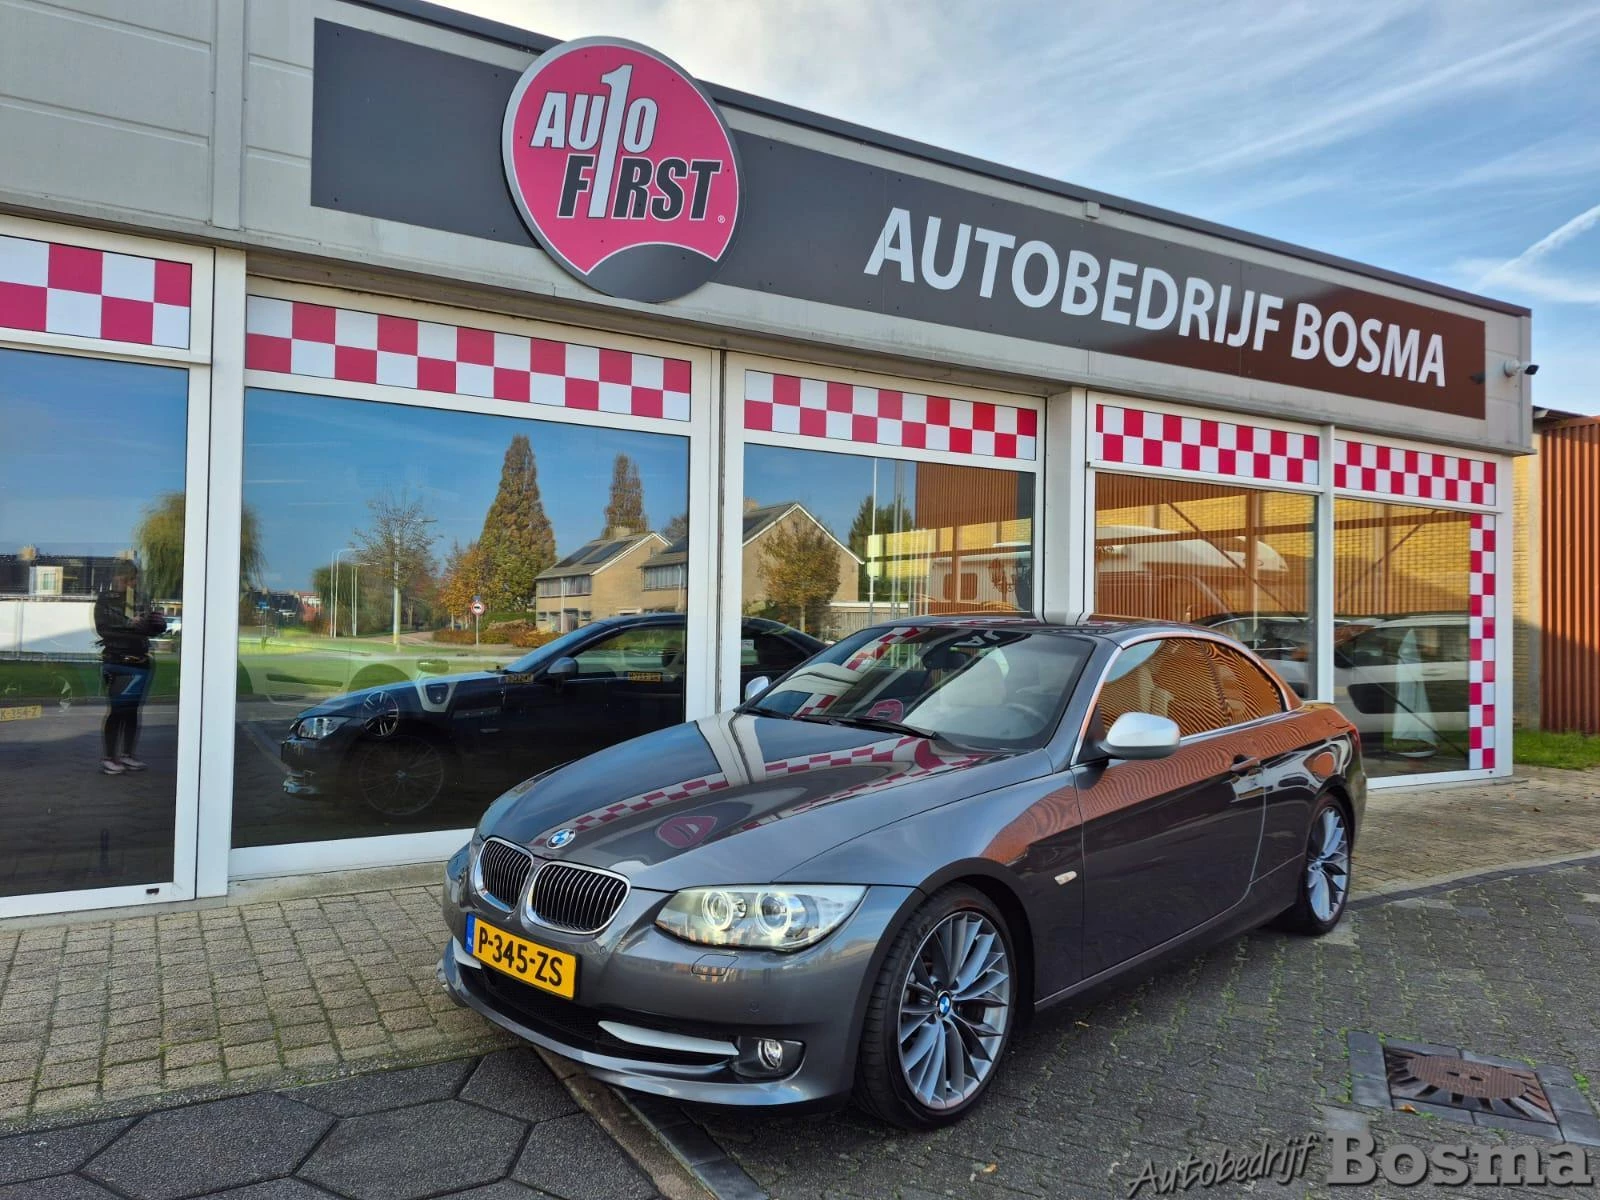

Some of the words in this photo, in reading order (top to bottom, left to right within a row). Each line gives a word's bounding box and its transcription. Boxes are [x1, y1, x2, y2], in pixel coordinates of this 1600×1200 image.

[864, 207, 1284, 352] AUTOBEDRIJF
[1291, 303, 1446, 387] BOSMA
[478, 926, 563, 987] P-345-ZS
